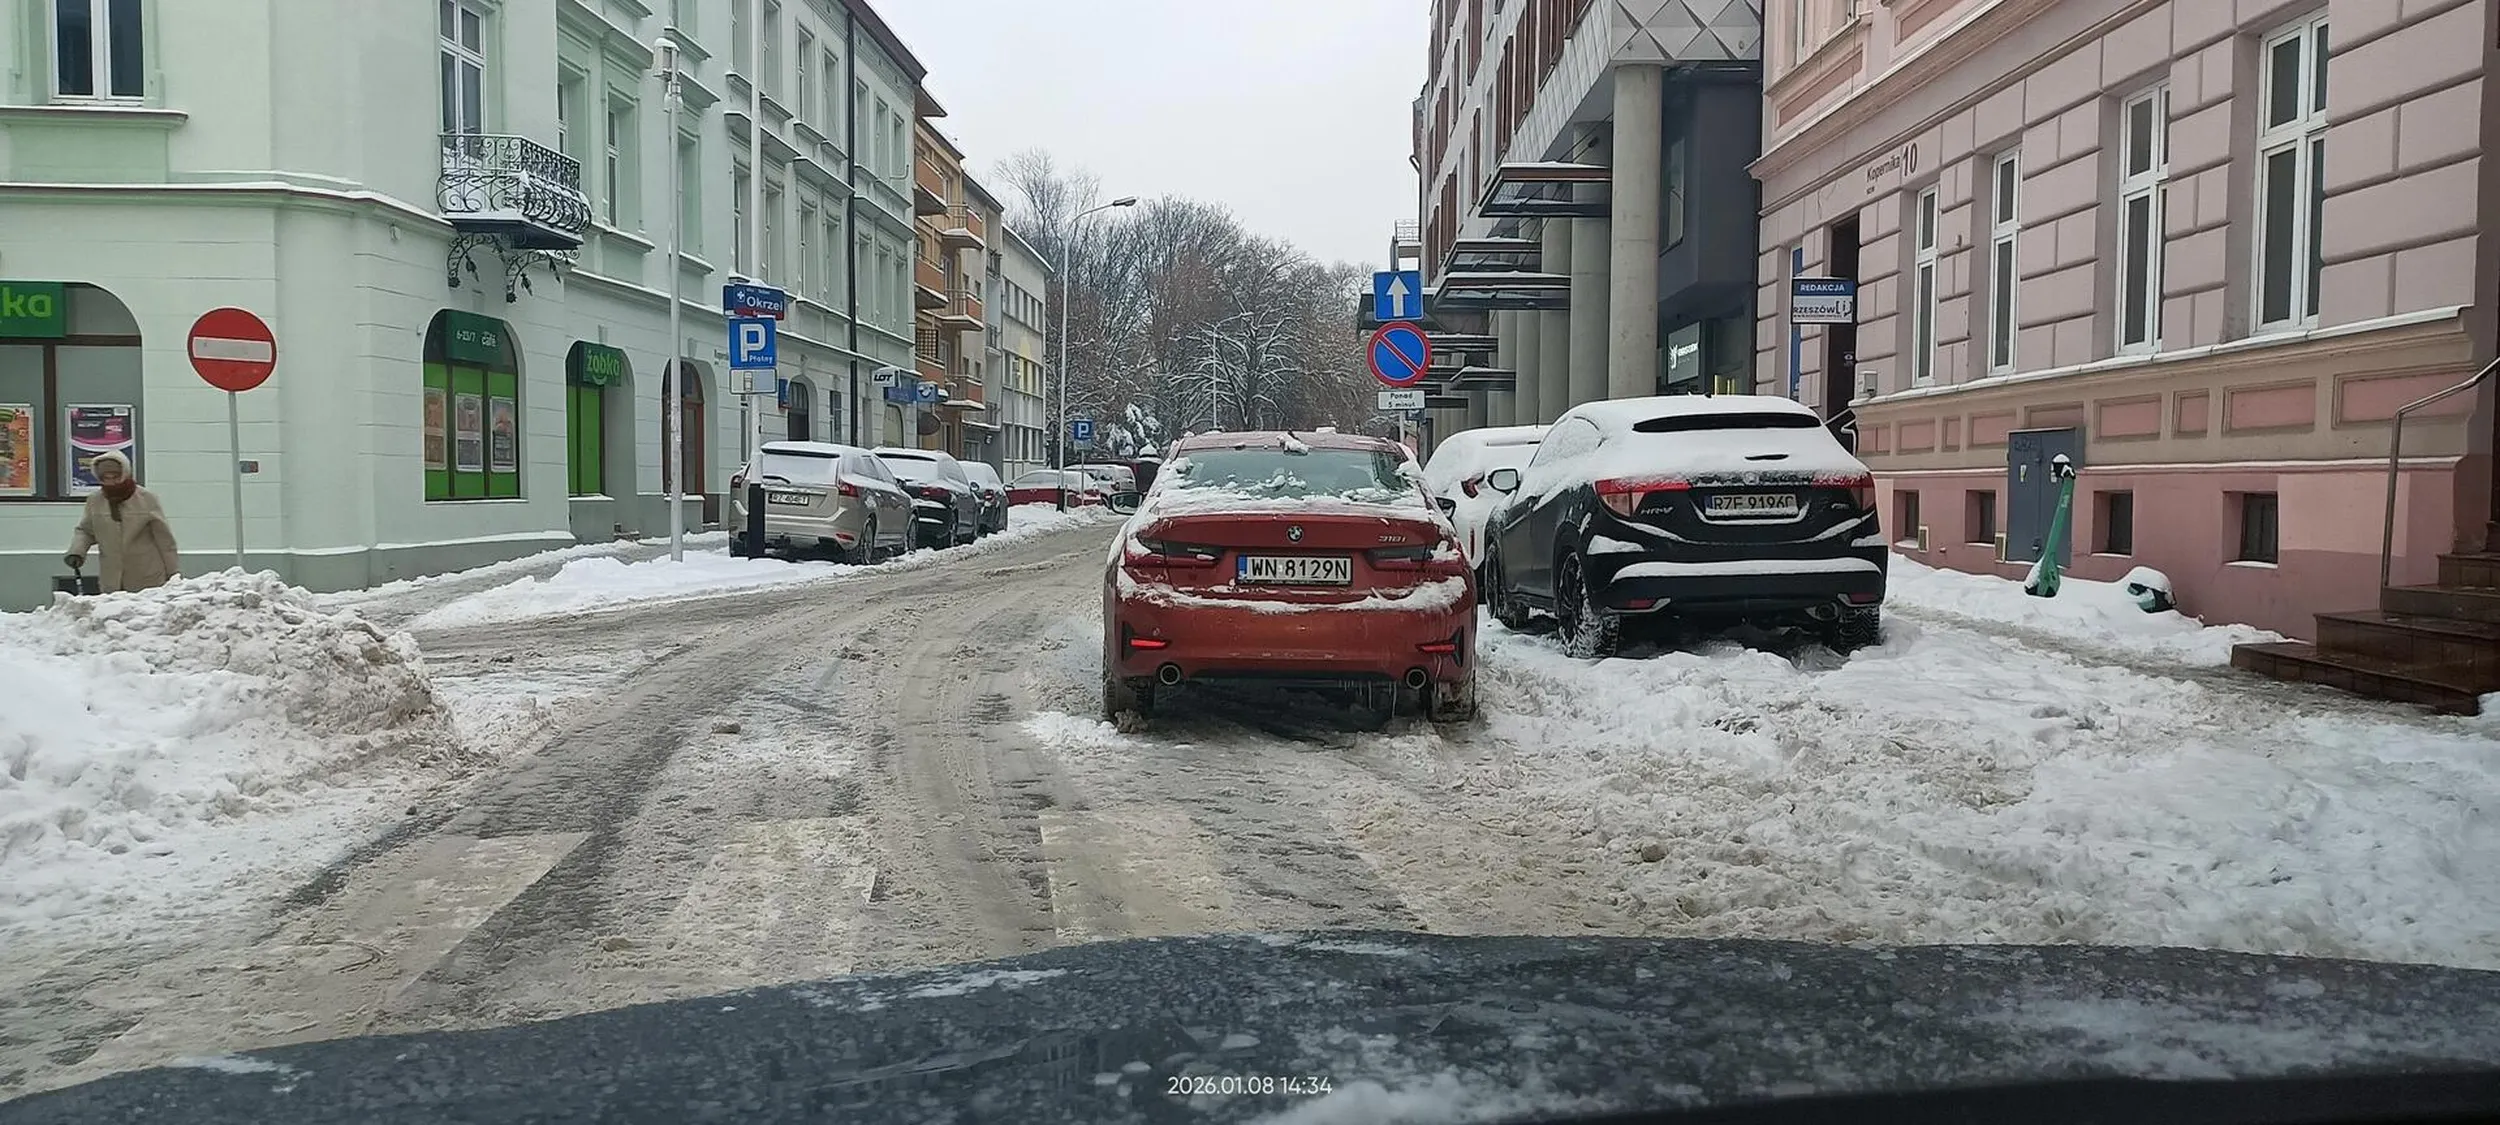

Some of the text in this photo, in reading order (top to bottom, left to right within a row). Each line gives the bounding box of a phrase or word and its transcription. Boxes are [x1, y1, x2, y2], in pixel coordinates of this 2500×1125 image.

[1902, 142, 1917, 177] 10
[1800, 283, 1845, 292] REDAKCJA
[1793, 305, 1836, 314] RZESZÓW
[740, 323, 766, 362] P
[874, 374, 893, 382] LOT
[1077, 422, 1090, 438] P
[1251, 558, 1348, 580] WN 8129N
